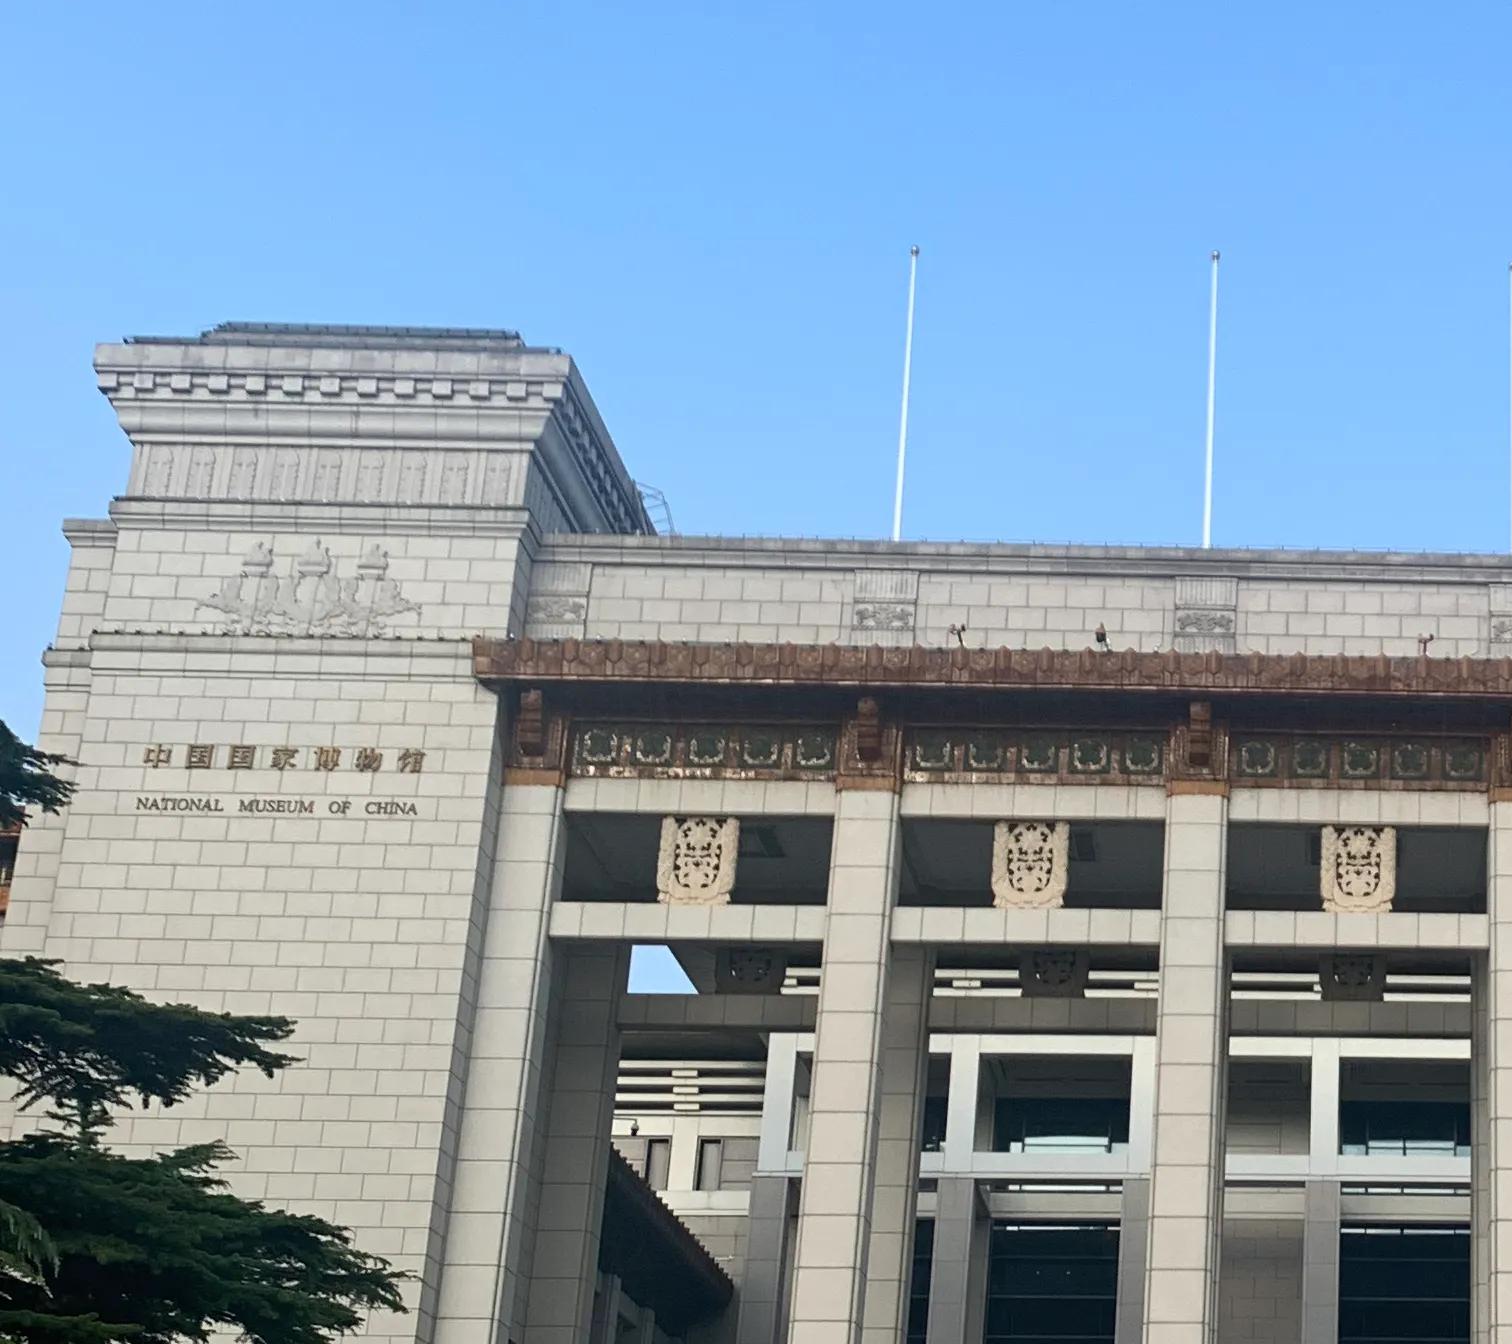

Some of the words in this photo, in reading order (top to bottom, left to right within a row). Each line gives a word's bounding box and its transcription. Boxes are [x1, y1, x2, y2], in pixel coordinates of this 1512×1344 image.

[143, 744, 426, 774] 中国国家博物馆
[136, 797, 224, 812] NATIONAL
[238, 799, 315, 814] MUSEUM
[328, 800, 352, 815] OF
[365, 801, 418, 816] CHINA
